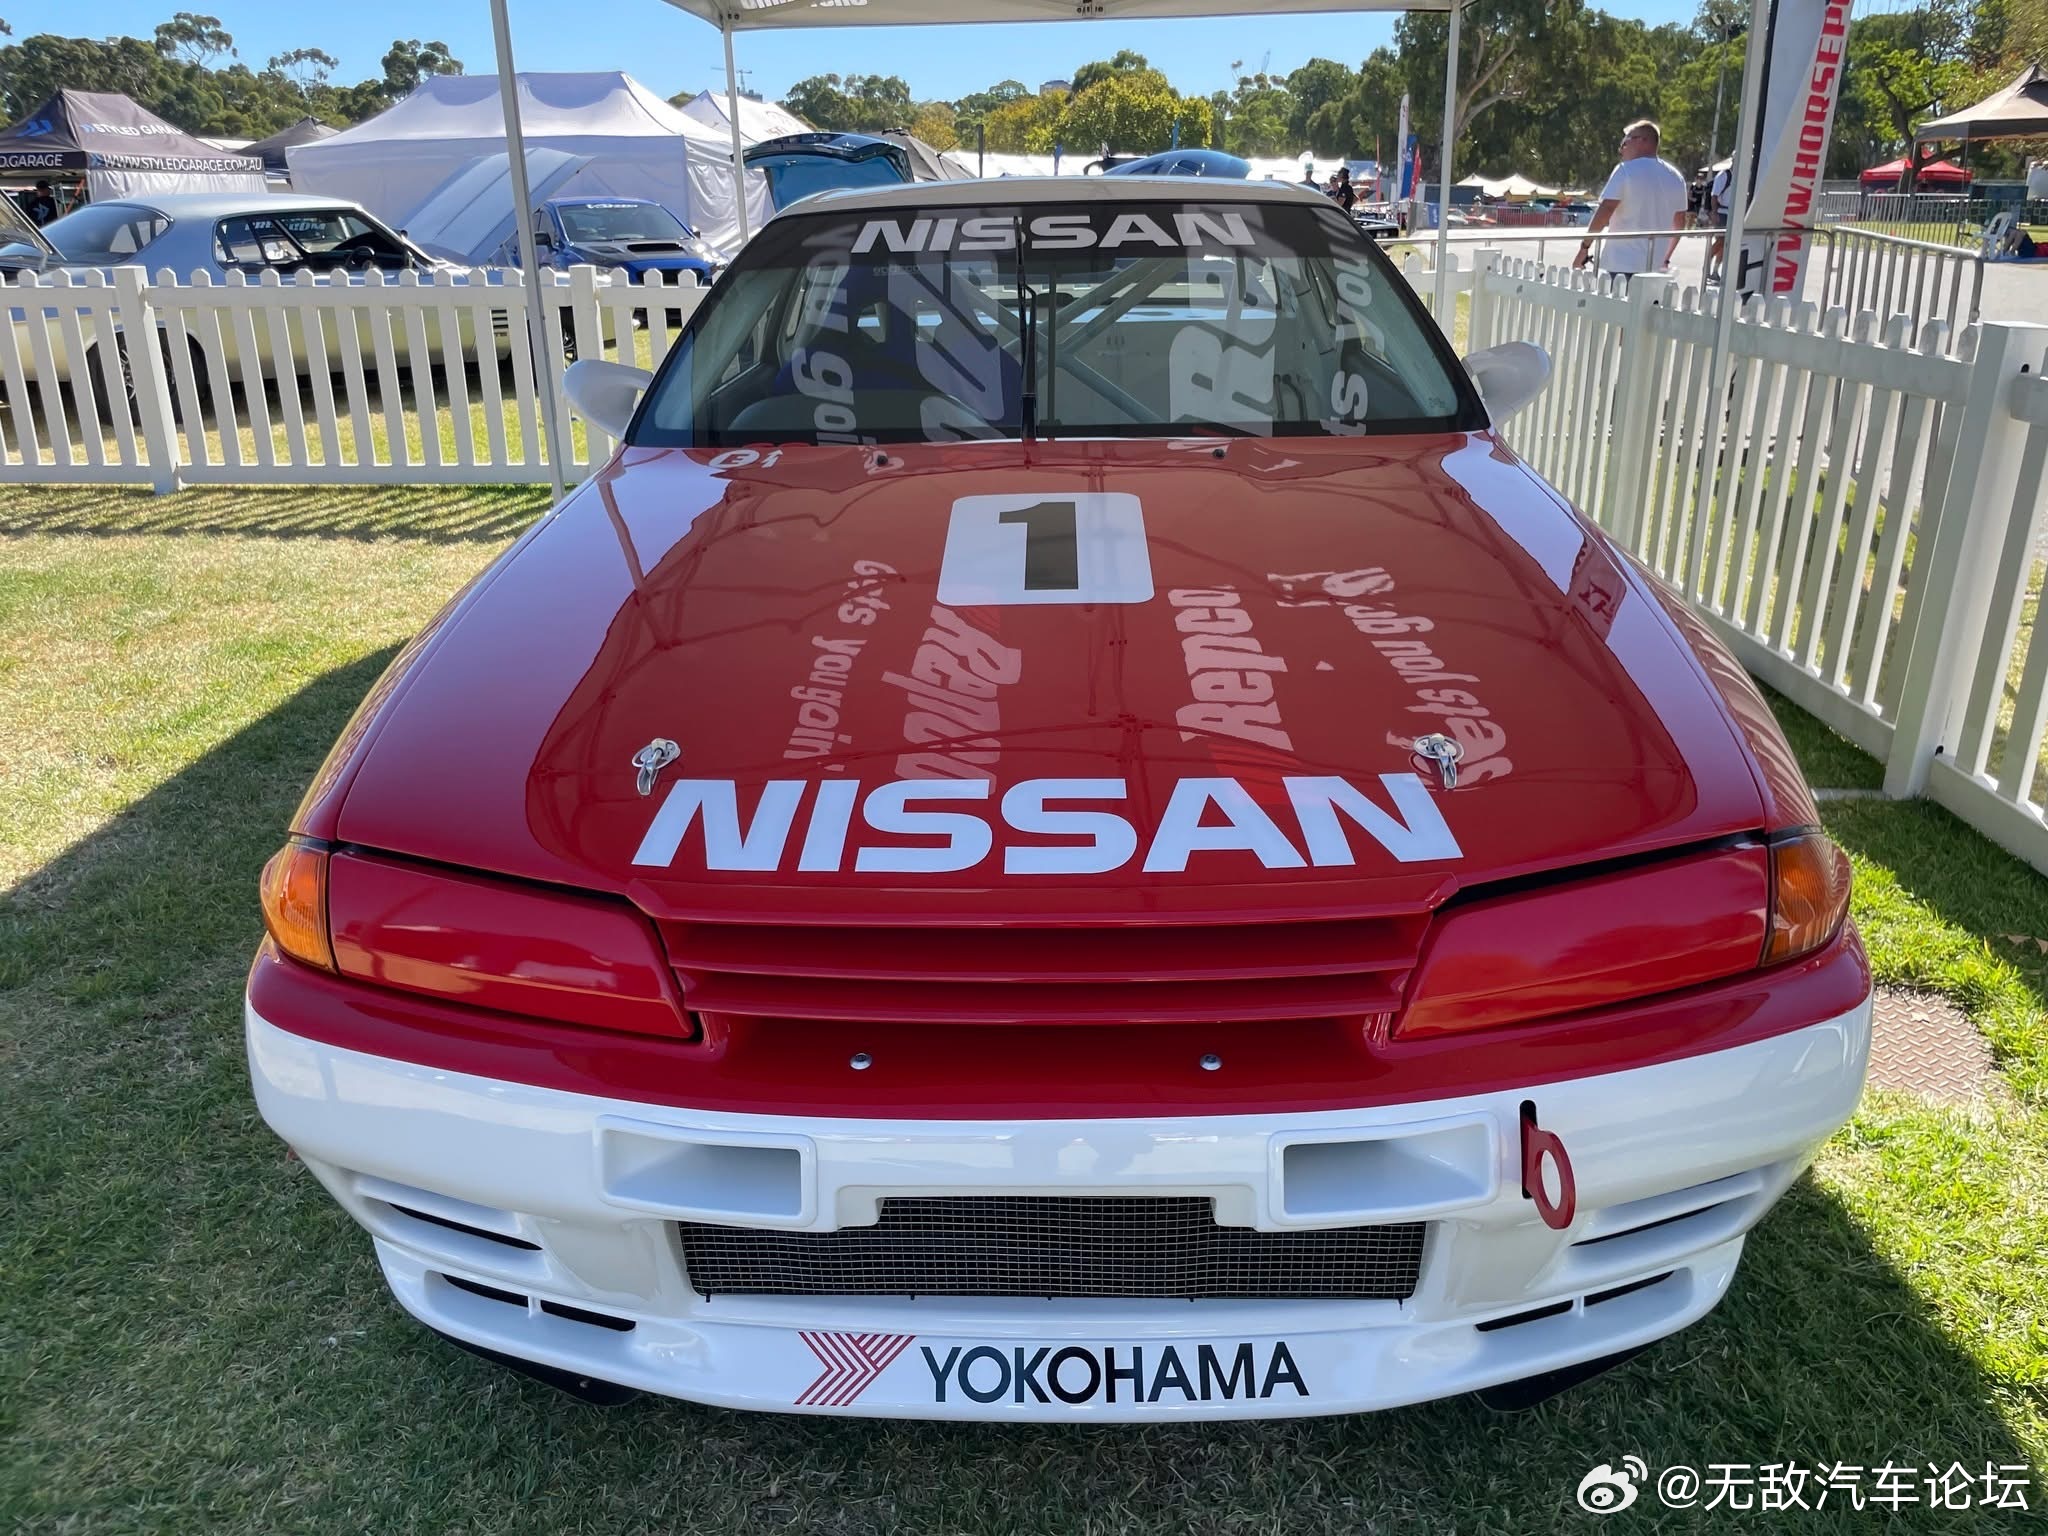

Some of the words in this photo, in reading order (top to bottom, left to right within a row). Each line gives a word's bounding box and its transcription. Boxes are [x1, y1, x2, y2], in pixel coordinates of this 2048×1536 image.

[96, 123, 139, 136] STYLED
[102, 154, 263, 172] WWW.STYLEDGARAGE.COM.AU
[851, 211, 1256, 253] NISSAN
[998, 501, 1079, 591] 1
[1168, 587, 1294, 752] Repco
[1371, 640, 1480, 684] you
[631, 773, 1463, 875] NISSAN
[919, 1341, 1310, 1404] YOKOHAMA
